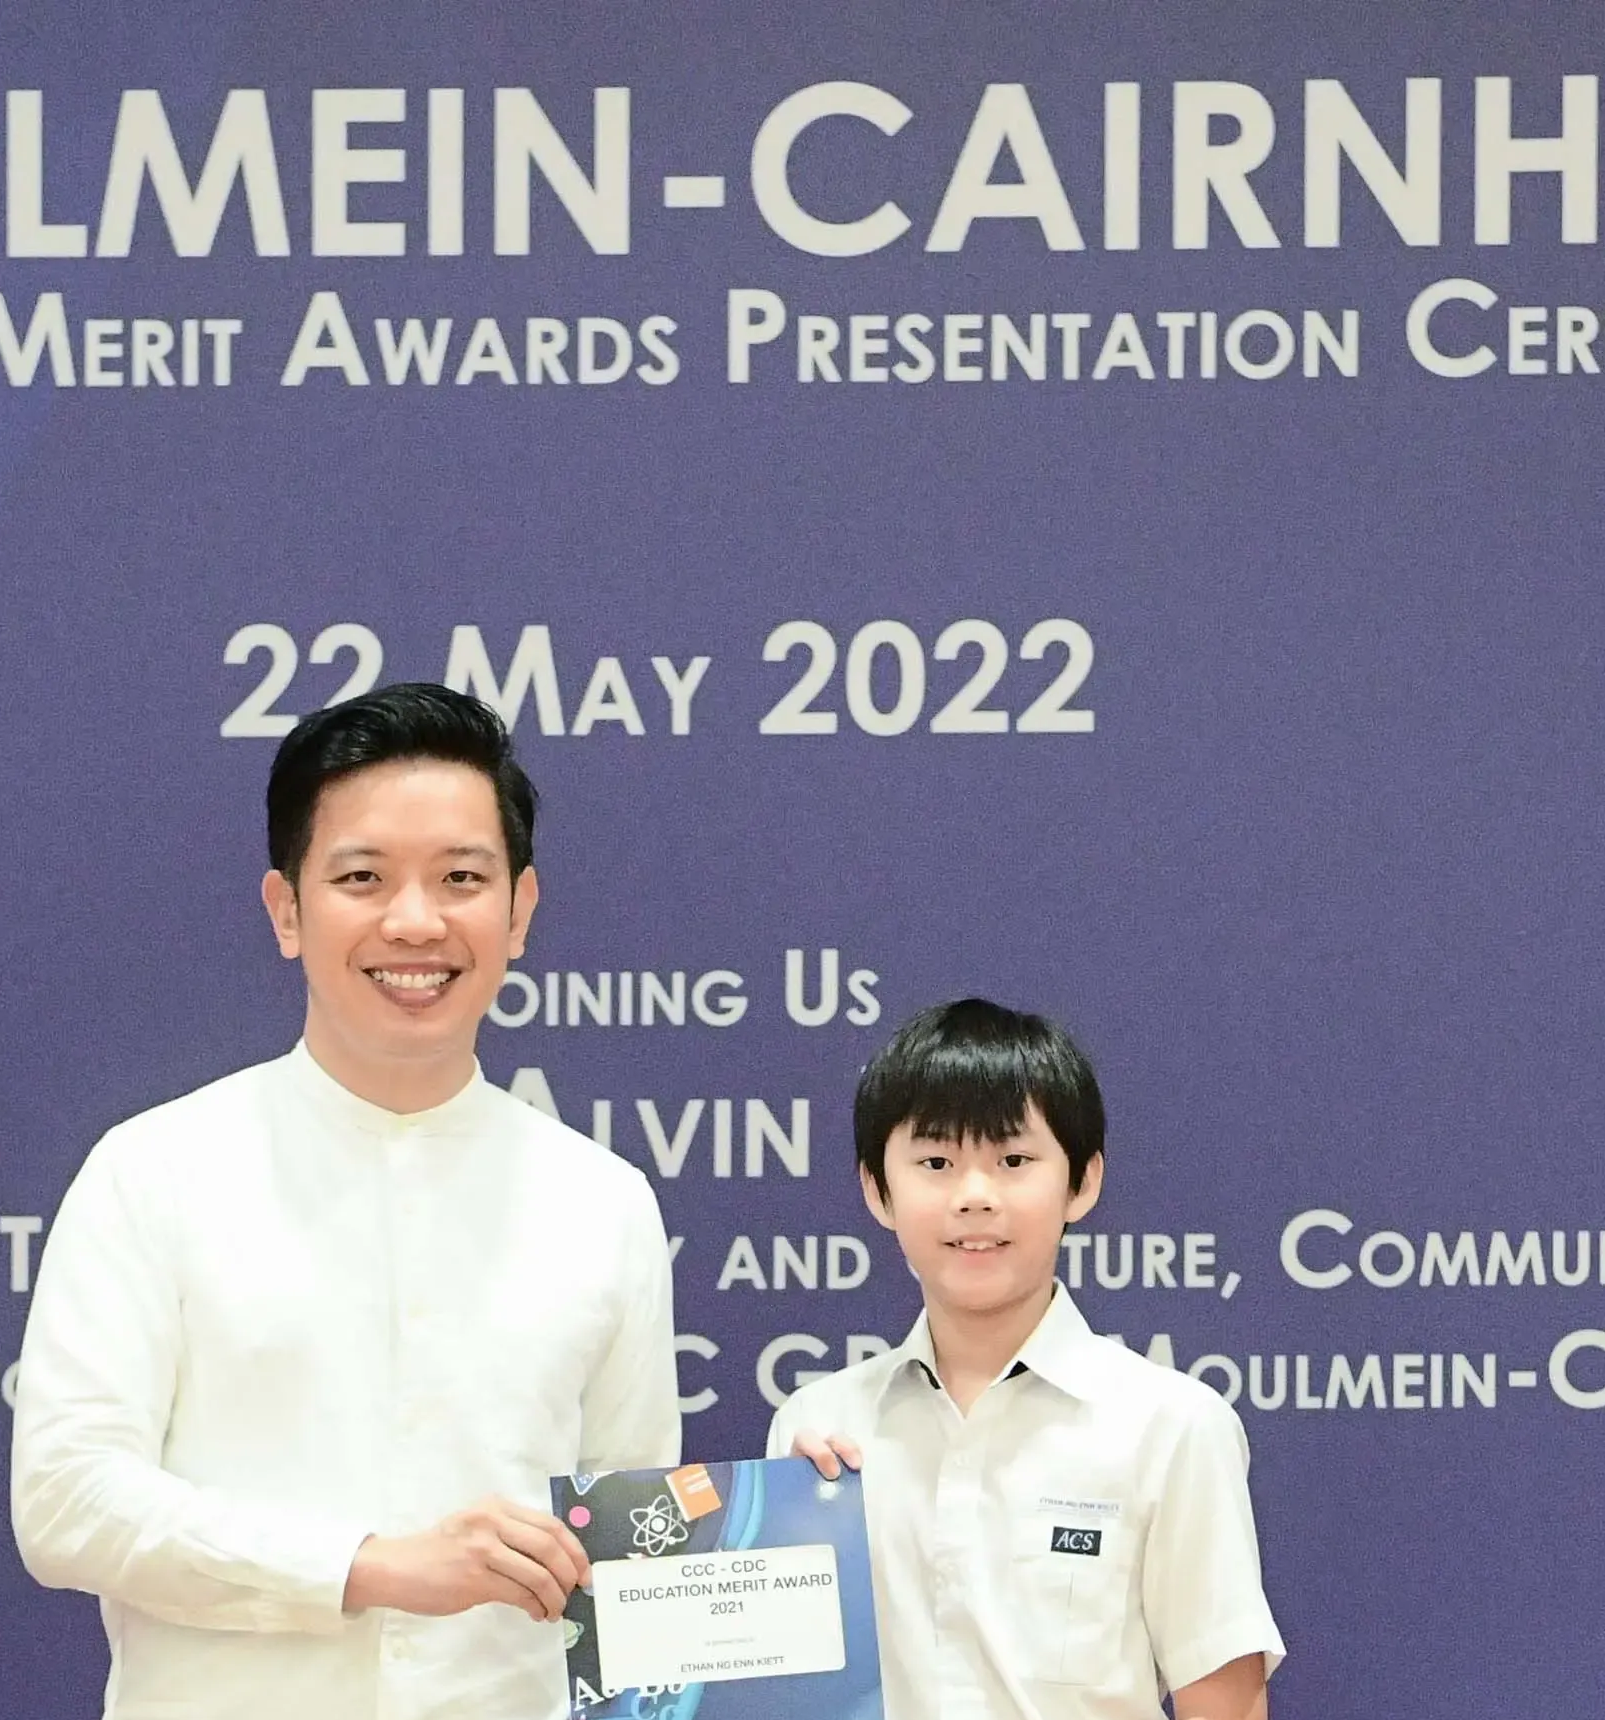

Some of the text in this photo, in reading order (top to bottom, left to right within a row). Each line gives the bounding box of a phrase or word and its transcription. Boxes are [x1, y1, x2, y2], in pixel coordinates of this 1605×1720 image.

[281, 291, 680, 386] AWARDS
[727, 288, 1359, 384] PRESENTATION
[221, 618, 1095, 737] 22 MAY 2022
[488, 948, 881, 1027] OINING US
[716, 1235, 871, 1290] AND
[1061, 1232, 1242, 1300] TURE,
[1055, 1530, 1094, 1550] ACS
[619, 1573, 832, 1602] EDUCATION MERIT AWARD
[681, 1563, 715, 1578] CCC
[731, 1559, 767, 1573] CDC
[710, 1601, 744, 1615] 2021
